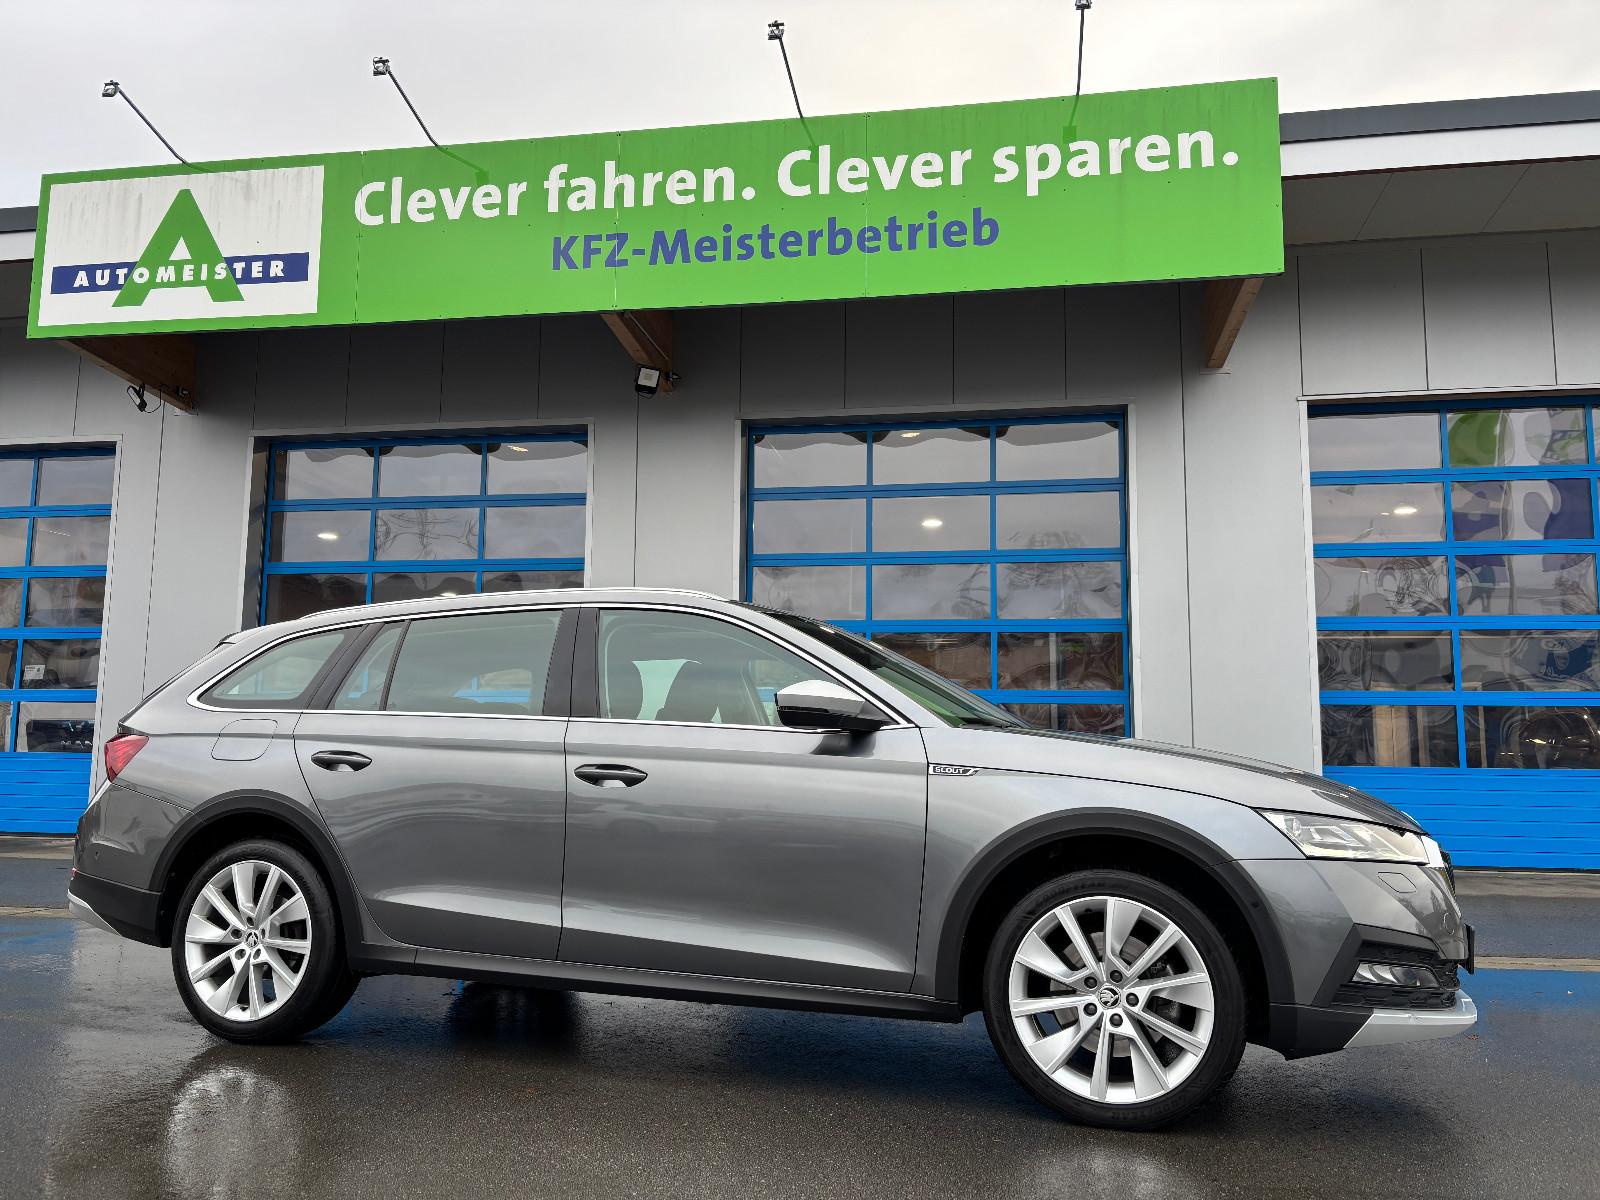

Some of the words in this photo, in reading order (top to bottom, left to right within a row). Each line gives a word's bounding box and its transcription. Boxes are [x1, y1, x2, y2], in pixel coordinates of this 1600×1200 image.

[354, 176, 528, 226] Clever
[543, 160, 756, 213] fahren.
[777, 144, 973, 197] Clever
[992, 130, 1239, 197] sparen.
[552, 207, 999, 271] KFZ-Meisterbetrieb
[72, 260, 286, 288] AUTOMEISTER
